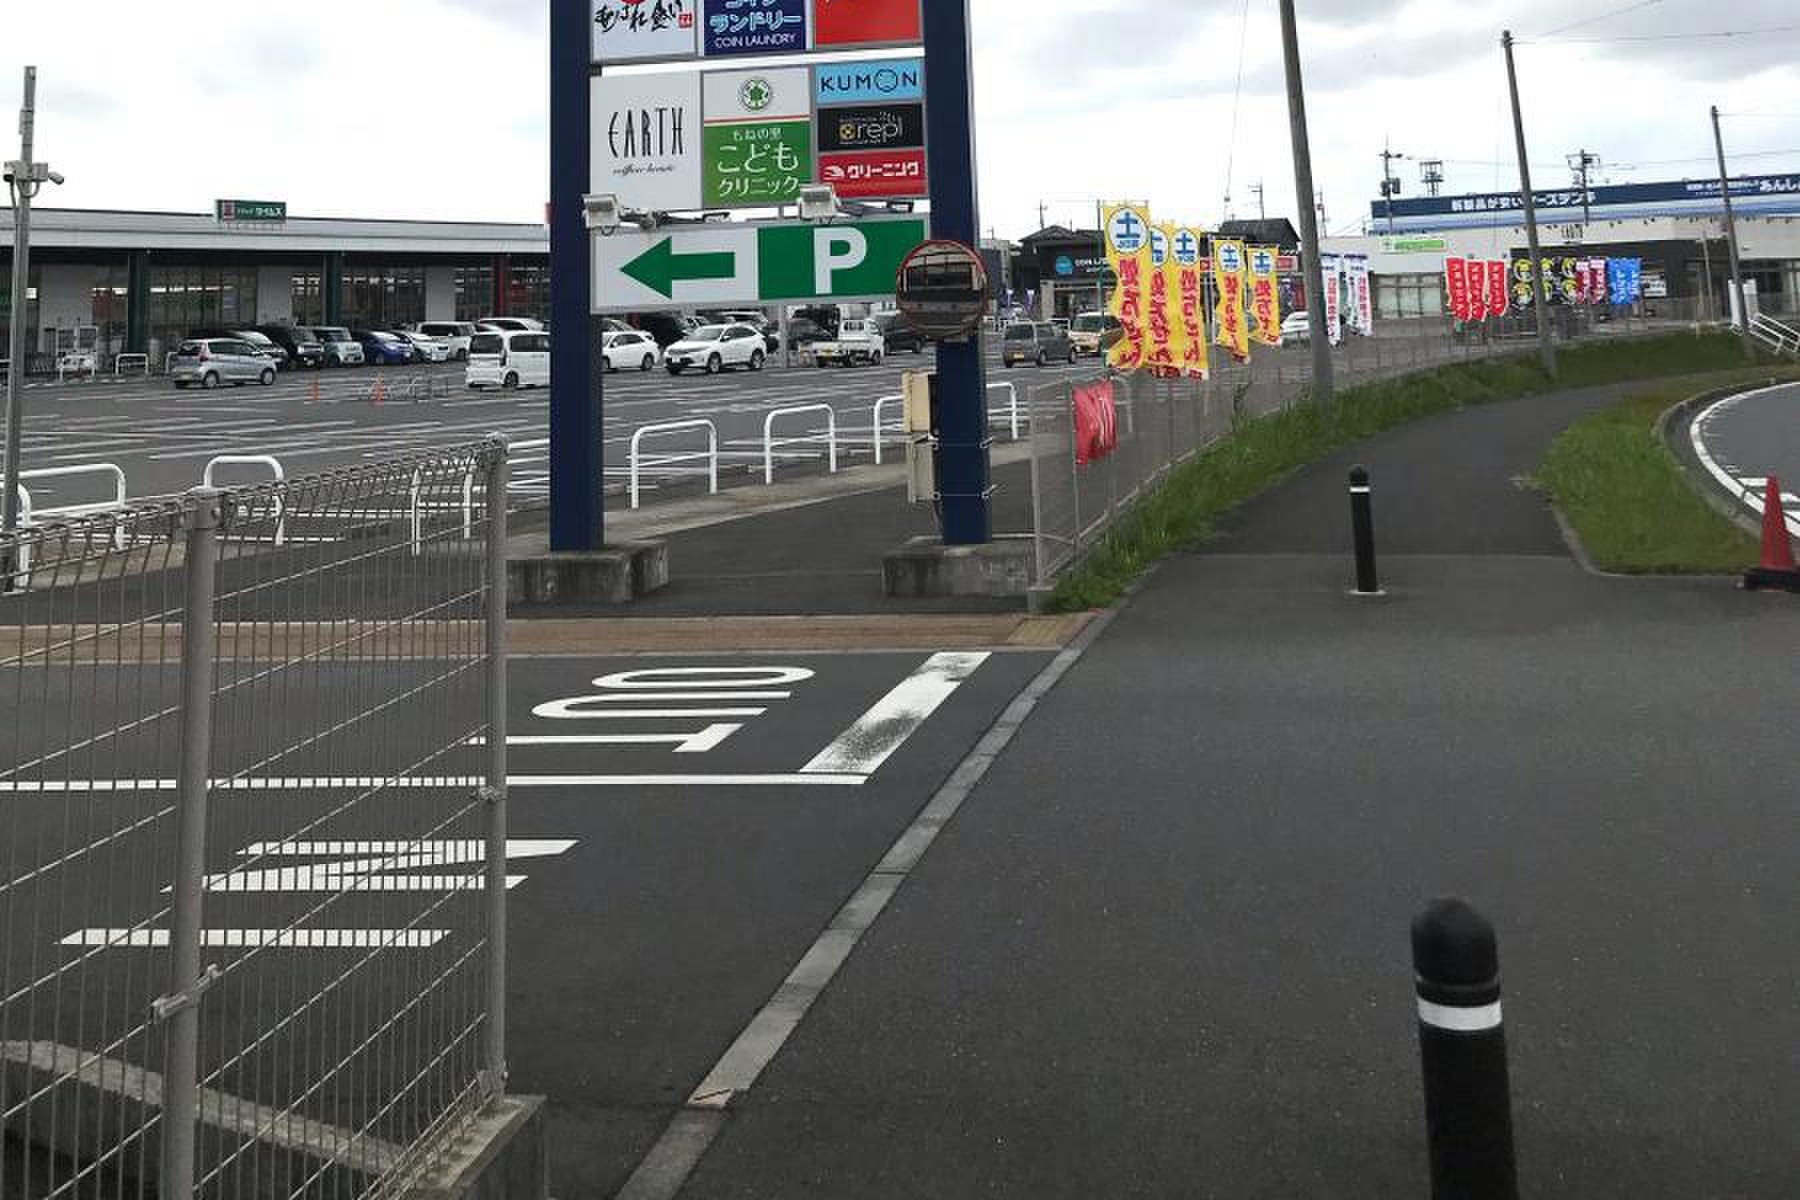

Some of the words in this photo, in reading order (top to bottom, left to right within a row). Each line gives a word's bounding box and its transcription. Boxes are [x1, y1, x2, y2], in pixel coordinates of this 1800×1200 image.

[709, 9, 802, 33] ランドリー
[714, 36, 743, 49] COIN
[745, 32, 797, 47] LAUNDRY
[820, 68, 917, 93] KUMON
[608, 106, 684, 158] EARTH
[732, 127, 782, 141] もねの里
[717, 141, 799, 173] こども
[846, 161, 919, 179] クリーニング
[718, 175, 799, 198] クリニック
[813, 225, 868, 295] P
